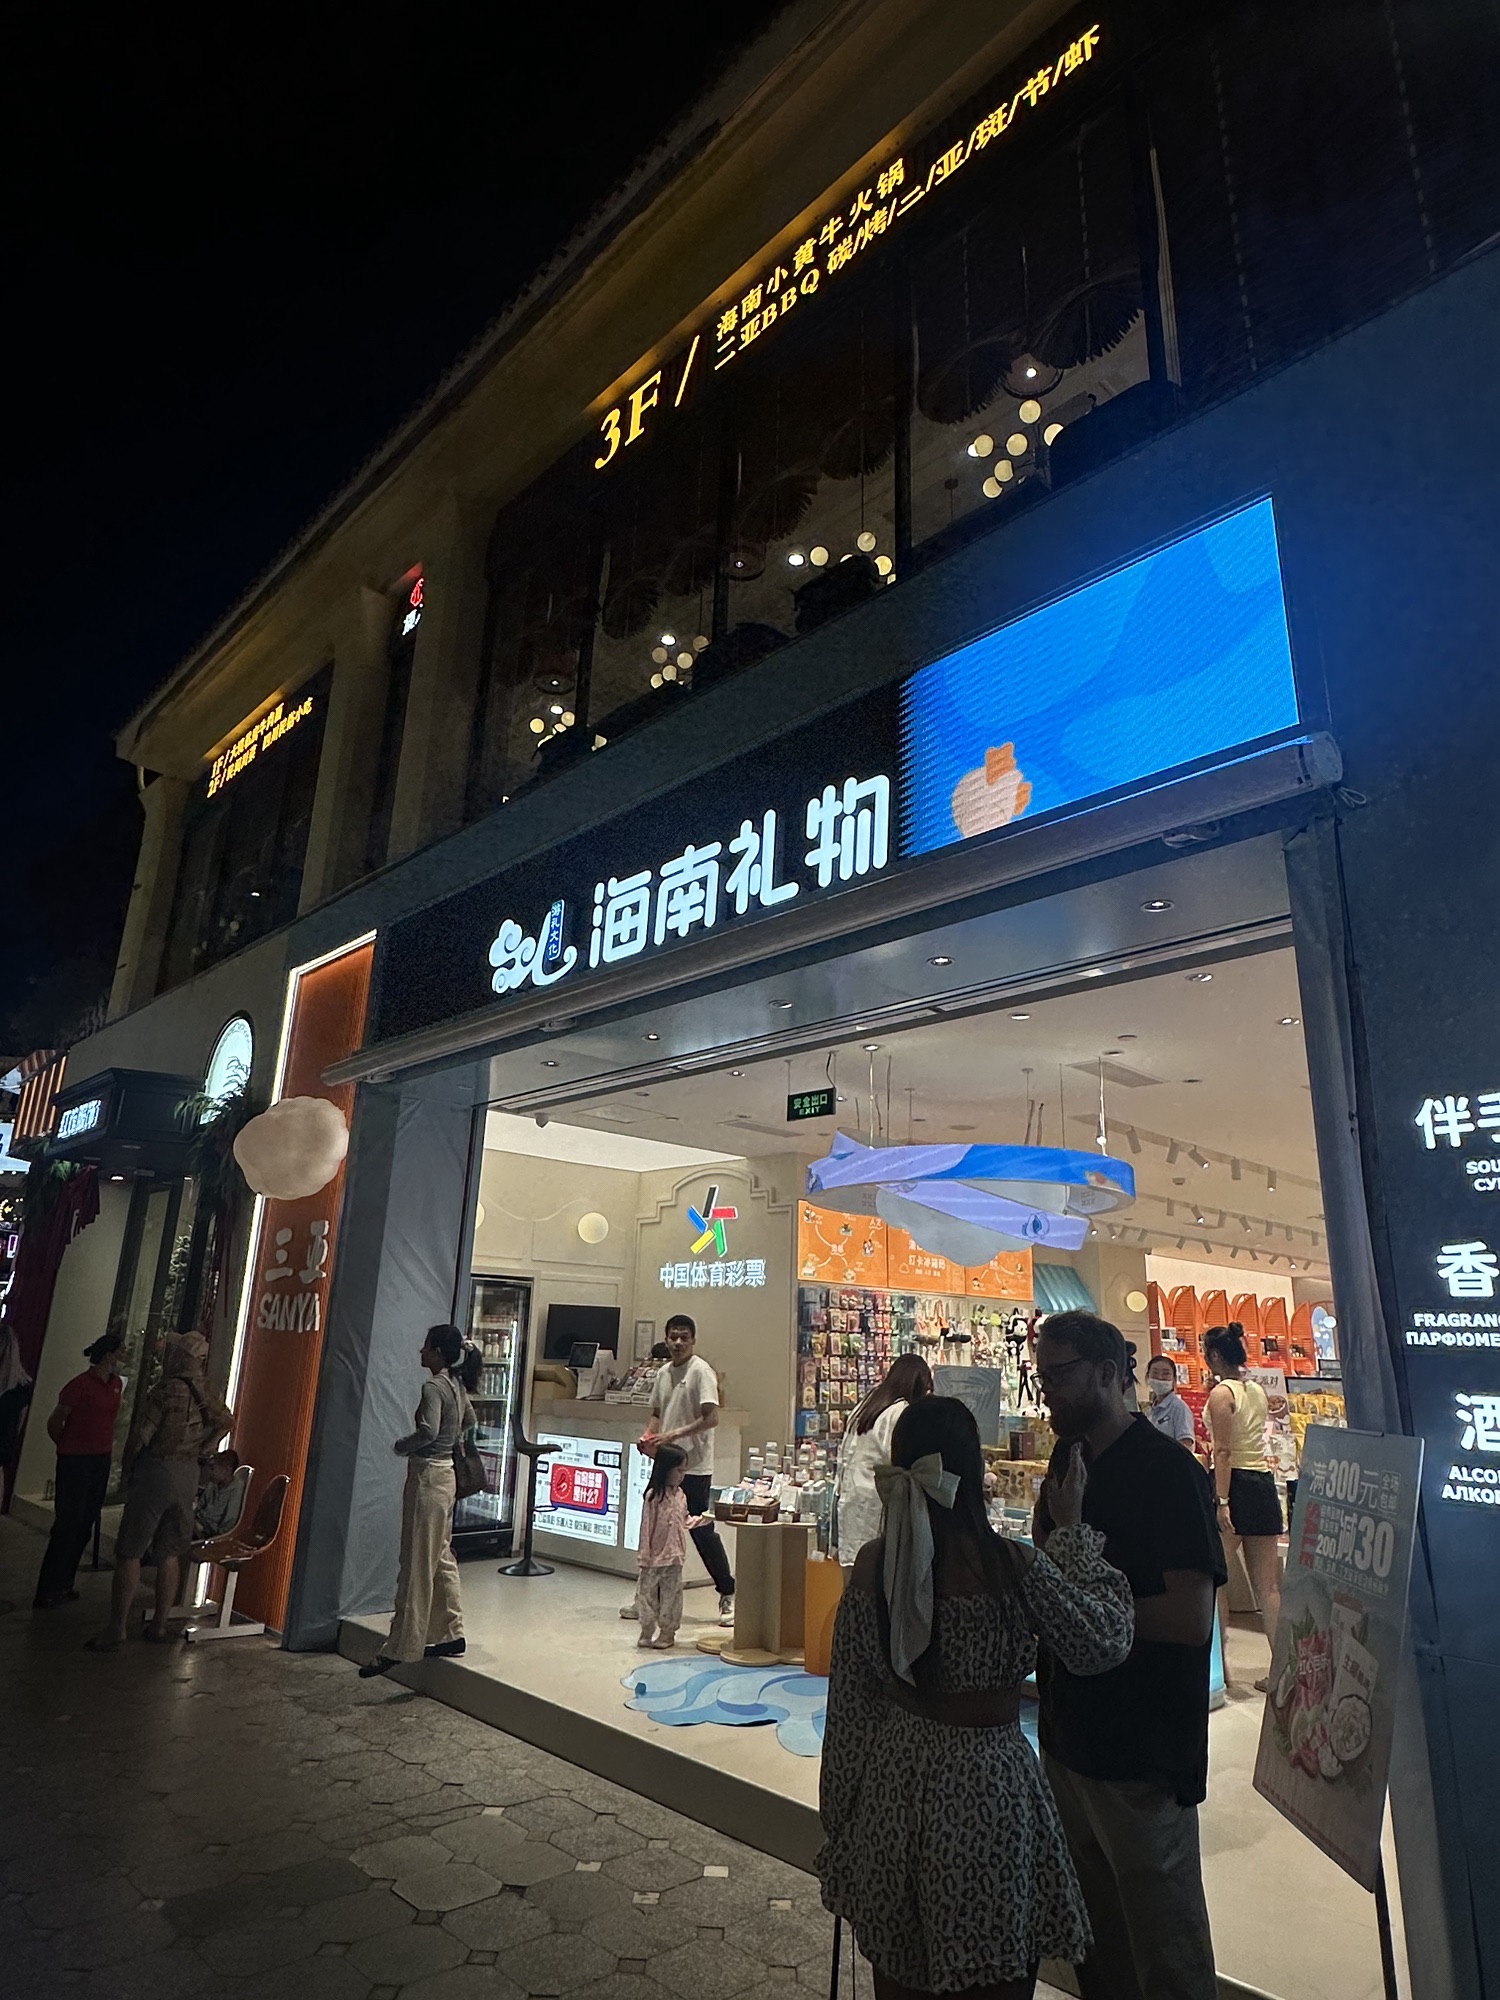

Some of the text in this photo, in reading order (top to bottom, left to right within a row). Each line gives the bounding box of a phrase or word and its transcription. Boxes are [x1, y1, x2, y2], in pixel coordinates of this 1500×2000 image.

[716, 158, 905, 341] 海南小黄牛火锅
[589, 774, 891, 969] 海南礼物
[793, 1093, 828, 1110] 安全出口
[799, 1106, 821, 1116] EXIT
[265, 1220, 329, 1284] 三亚
[659, 1258, 767, 1289] 中国体育彩票
[256, 1292, 321, 1333] SANYA
[1413, 1312, 1500, 1328] FRAGRAN
[1309, 1459, 1379, 1509] 满300元
[1449, 1465, 1500, 1484] ALCO
